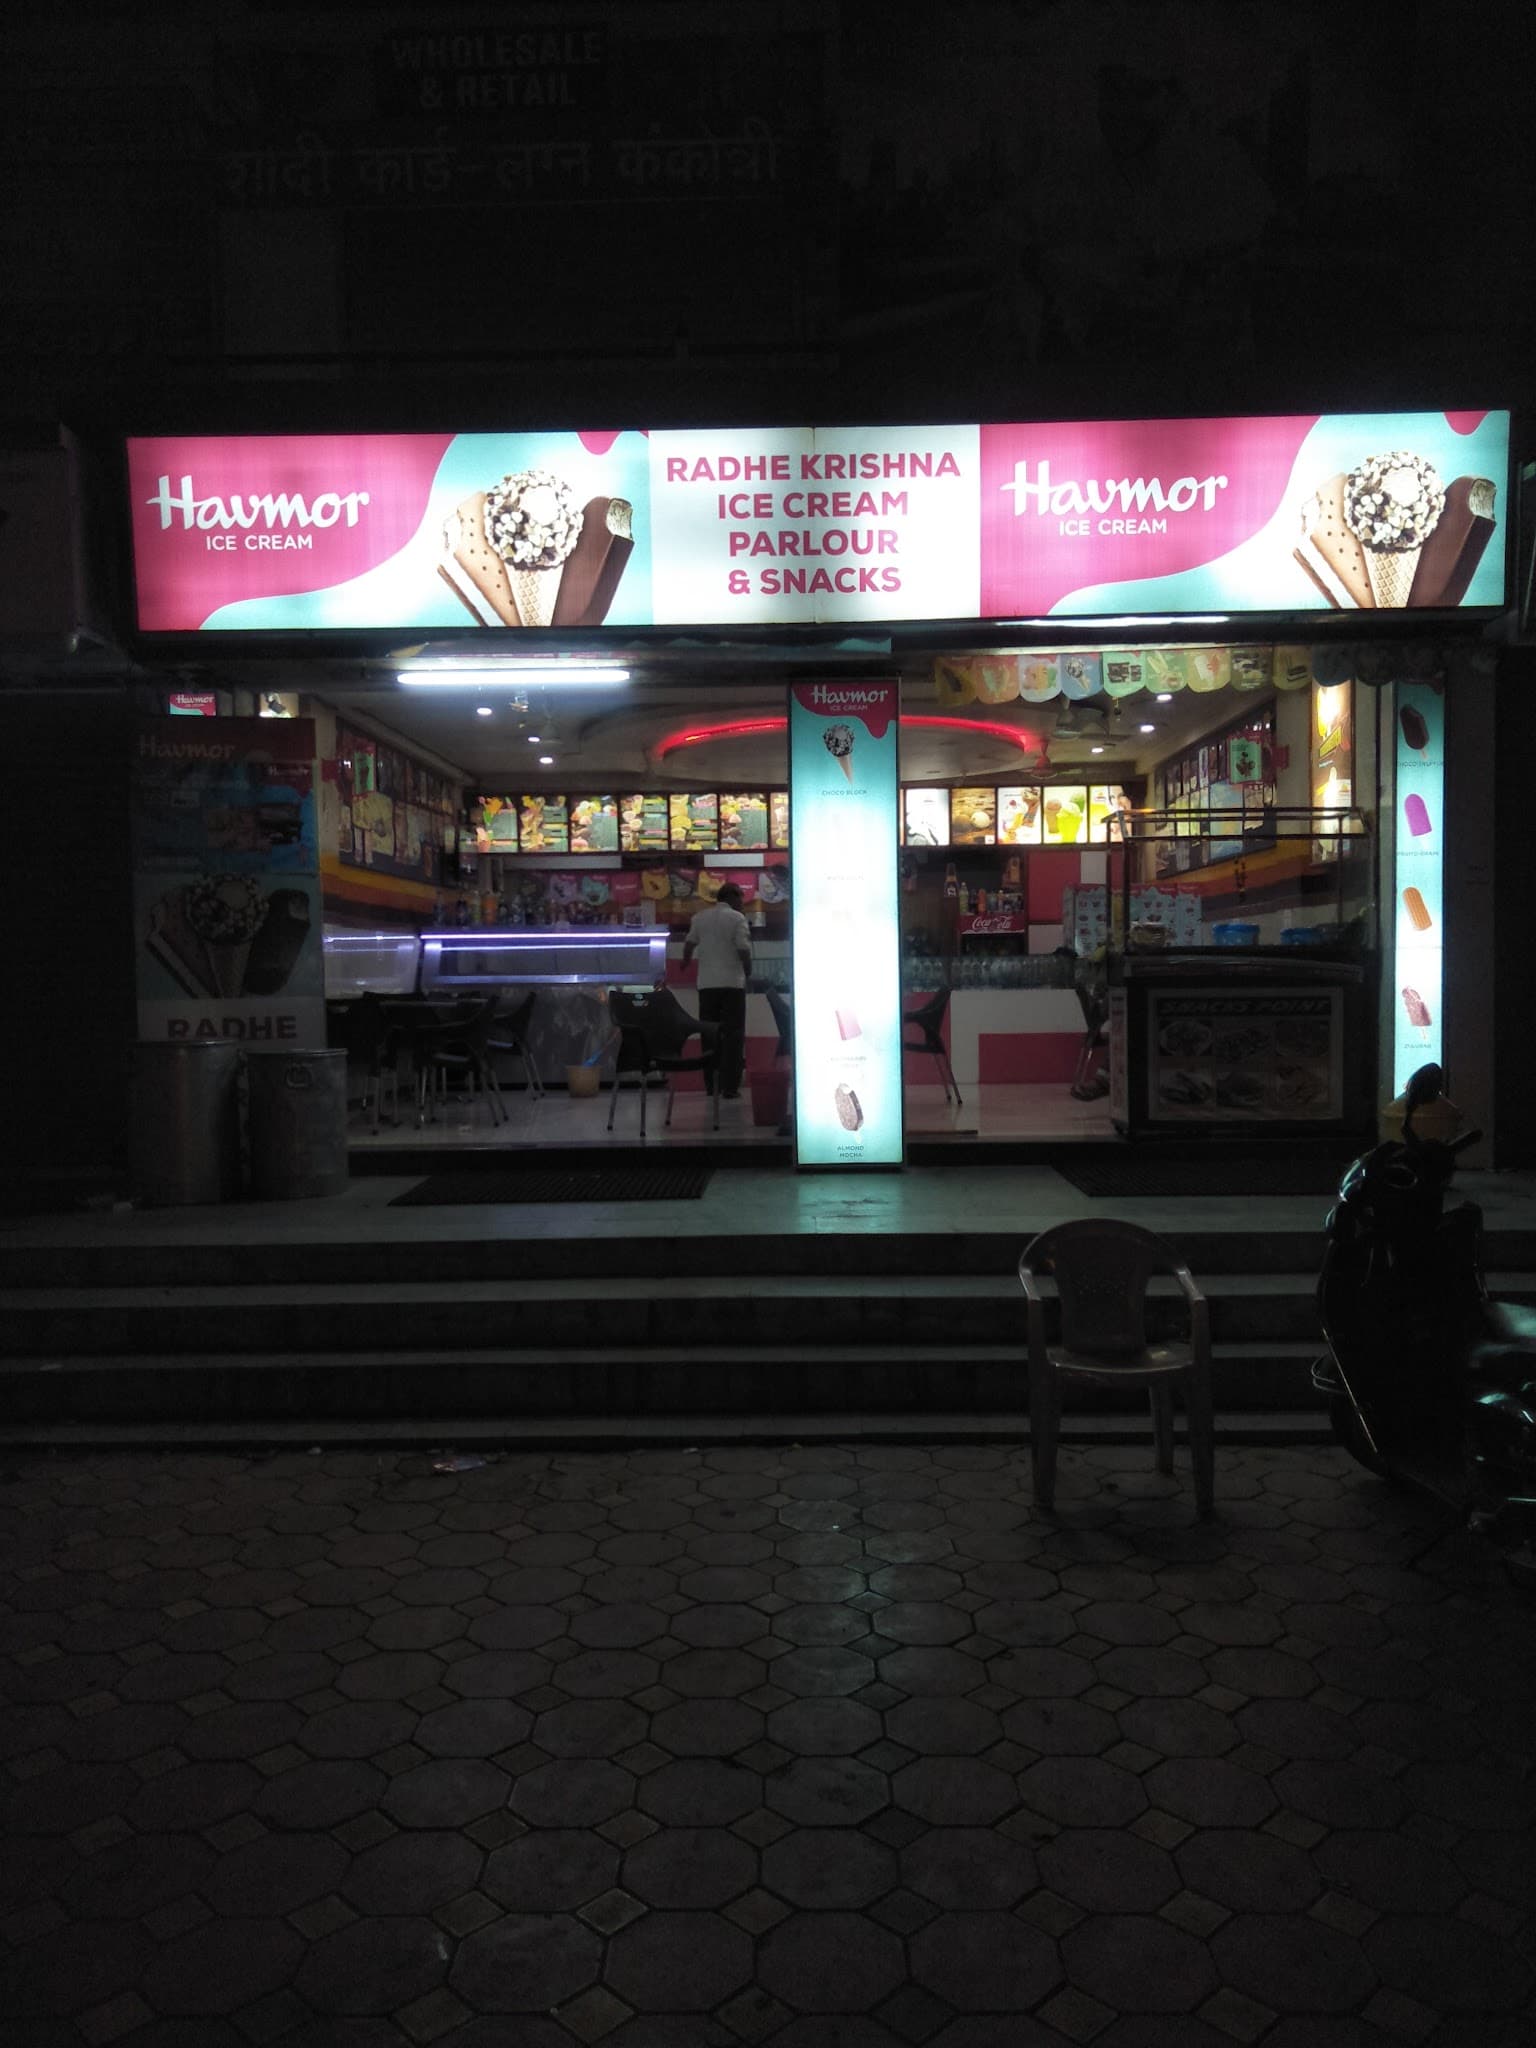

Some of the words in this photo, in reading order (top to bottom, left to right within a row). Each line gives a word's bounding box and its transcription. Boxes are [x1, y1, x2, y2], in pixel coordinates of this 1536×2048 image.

[391, 32, 603, 70] WHOLESALE
[418, 77, 444, 109] &
[456, 73, 577, 107] RETAIL
[666, 455, 791, 482] RADHE
[801, 452, 962, 480] KRISHNA
[145, 474, 370, 530] Havmor
[999, 459, 1229, 517] Havmor
[718, 493, 774, 520] ICE
[783, 491, 909, 518] CREAM
[1058, 519, 1091, 536] ICE
[1097, 517, 1168, 535] CREAM
[205, 535, 238, 551] ICE
[244, 534, 314, 551] CREAM
[729, 529, 900, 557] PARLOUR
[728, 569, 751, 596] &
[760, 567, 902, 595] SNACKS
[811, 684, 889, 705] Havmor
[137, 734, 236, 759] Havmor
[167, 1016, 298, 1041] RADHE
